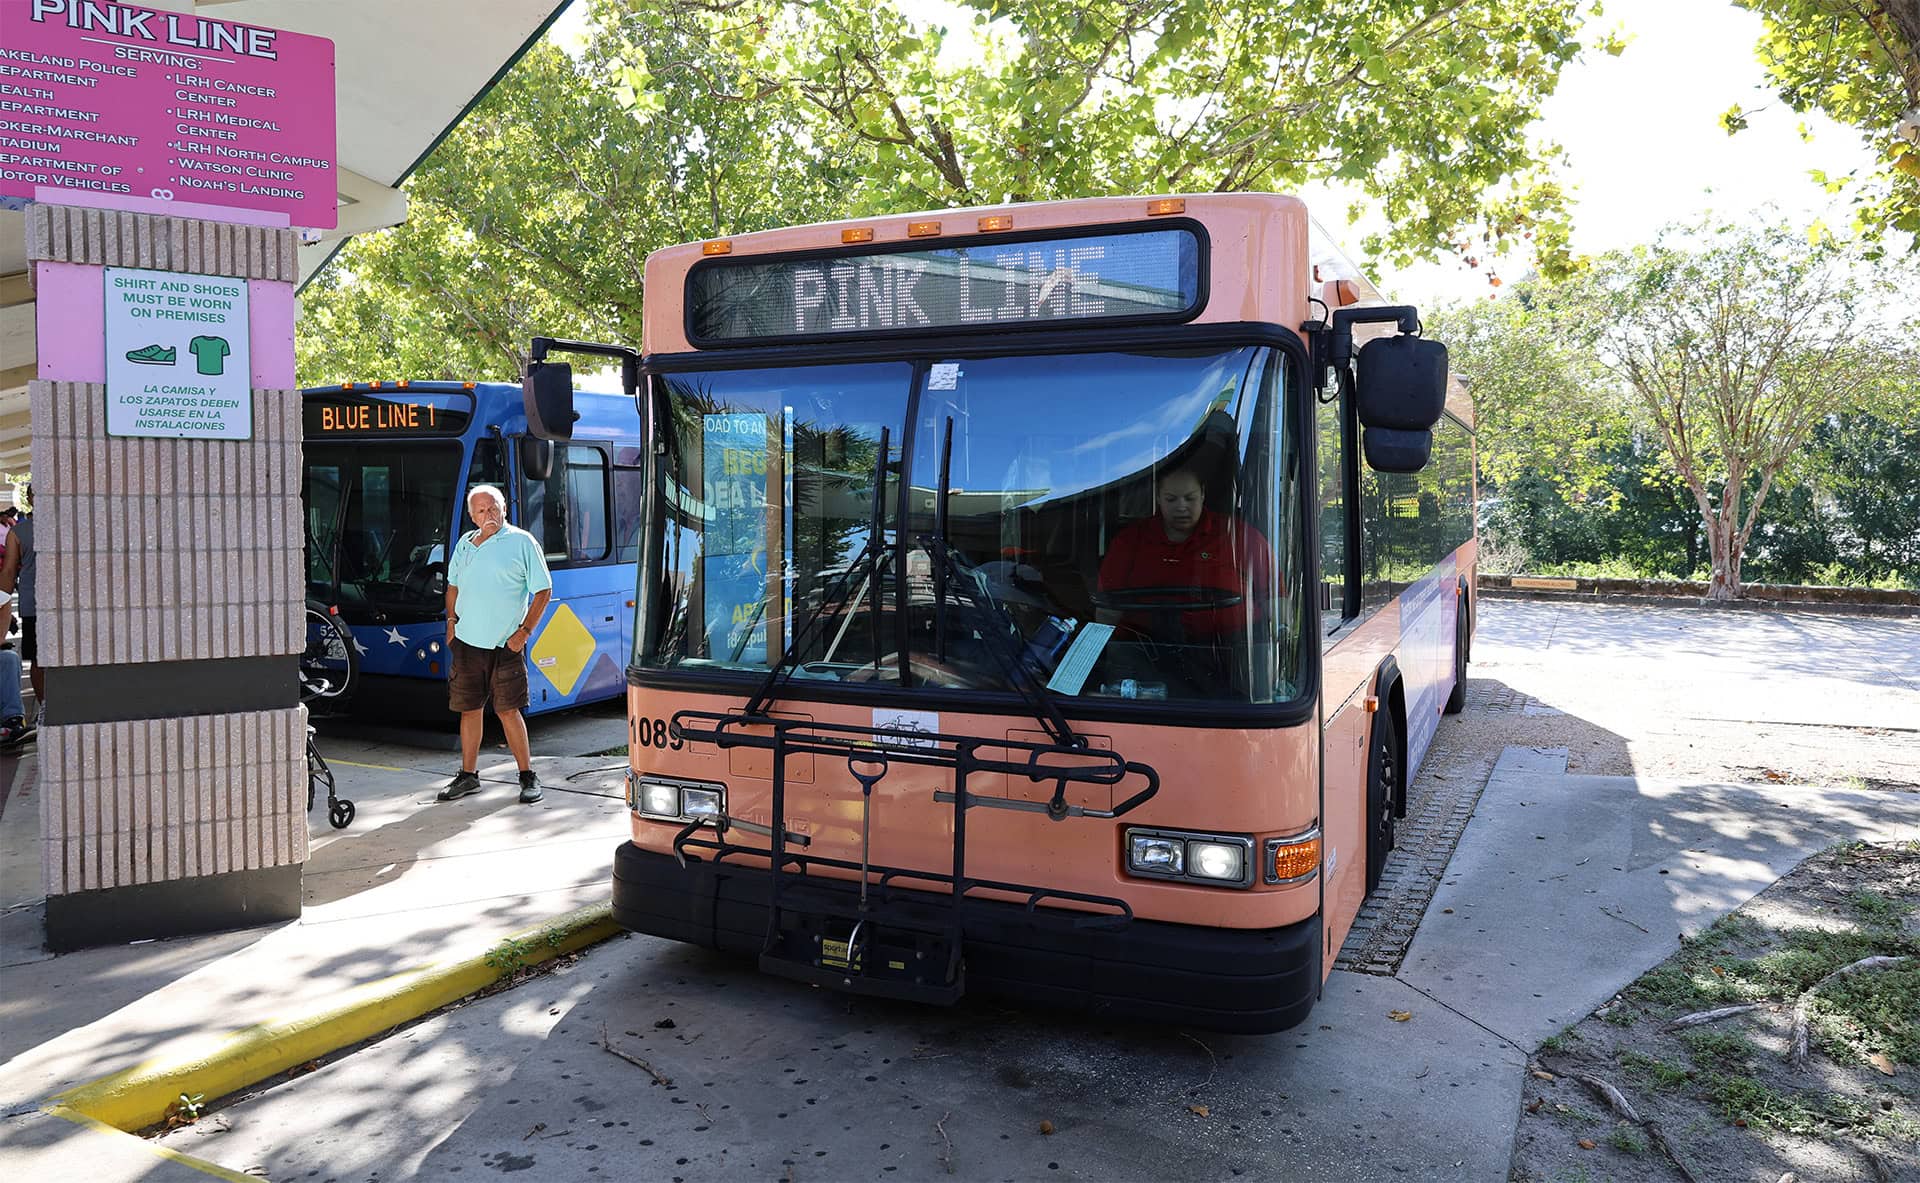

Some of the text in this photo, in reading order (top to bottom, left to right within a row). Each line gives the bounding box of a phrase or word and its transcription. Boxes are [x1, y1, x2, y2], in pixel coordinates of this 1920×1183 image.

[31, 0, 278, 60] PINK LINE
[79, 58, 137, 78] POLICE
[114, 46, 203, 71] SERVING:
[175, 73, 276, 98] LRH CANCER
[175, 89, 237, 108] CENTER
[176, 107, 281, 132] LRH MEDICAL
[176, 123, 237, 141] CENTER
[177, 140, 330, 170] LRH NORTH CAMPUS
[100, 165, 122, 176] OF
[177, 157, 295, 182] WATSON CLINIC
[0, 167, 131, 194] OTOR VEHICLES
[179, 175, 305, 201] NOAH'S LANDING
[114, 277, 240, 298] SHIRT AND SHOES
[794, 246, 1105, 331] PINK LINE
[123, 293, 232, 311] MUST BE WORN
[130, 306, 226, 324] ON PREMISES
[143, 385, 217, 396] LA CAMISA Y
[119, 396, 240, 409] LOS ZAPATOS DEBEN
[139, 408, 221, 420] USARSE EN LA
[322, 402, 435, 430] BLUE LINE 1
[135, 420, 226, 431] INSTALACIONES
[704, 417, 730, 433] OAD
[734, 419, 749, 434] TO
